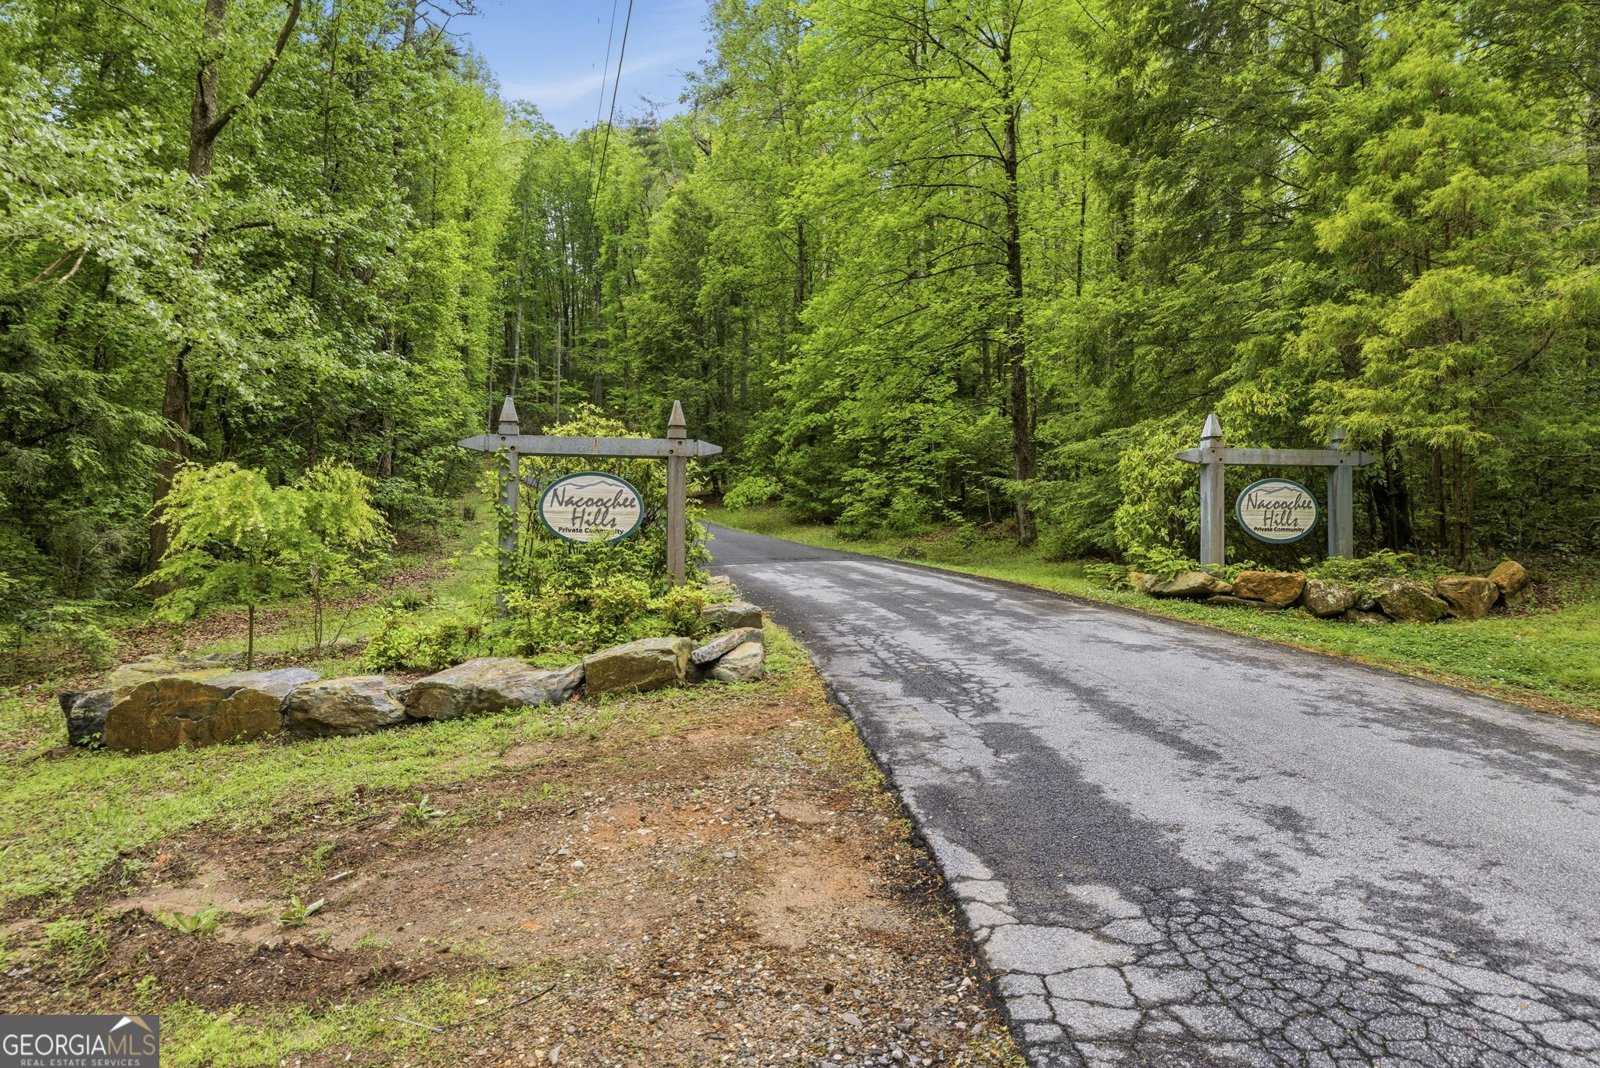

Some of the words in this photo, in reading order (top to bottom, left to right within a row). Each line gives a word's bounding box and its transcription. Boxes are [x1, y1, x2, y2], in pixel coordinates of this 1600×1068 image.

[550, 487, 636, 509] Nacoochee
[1246, 492, 1312, 510] Nacoochee
[571, 508, 617, 528] Hills
[1263, 510, 1298, 527] Hills
[558, 526, 583, 534] Private
